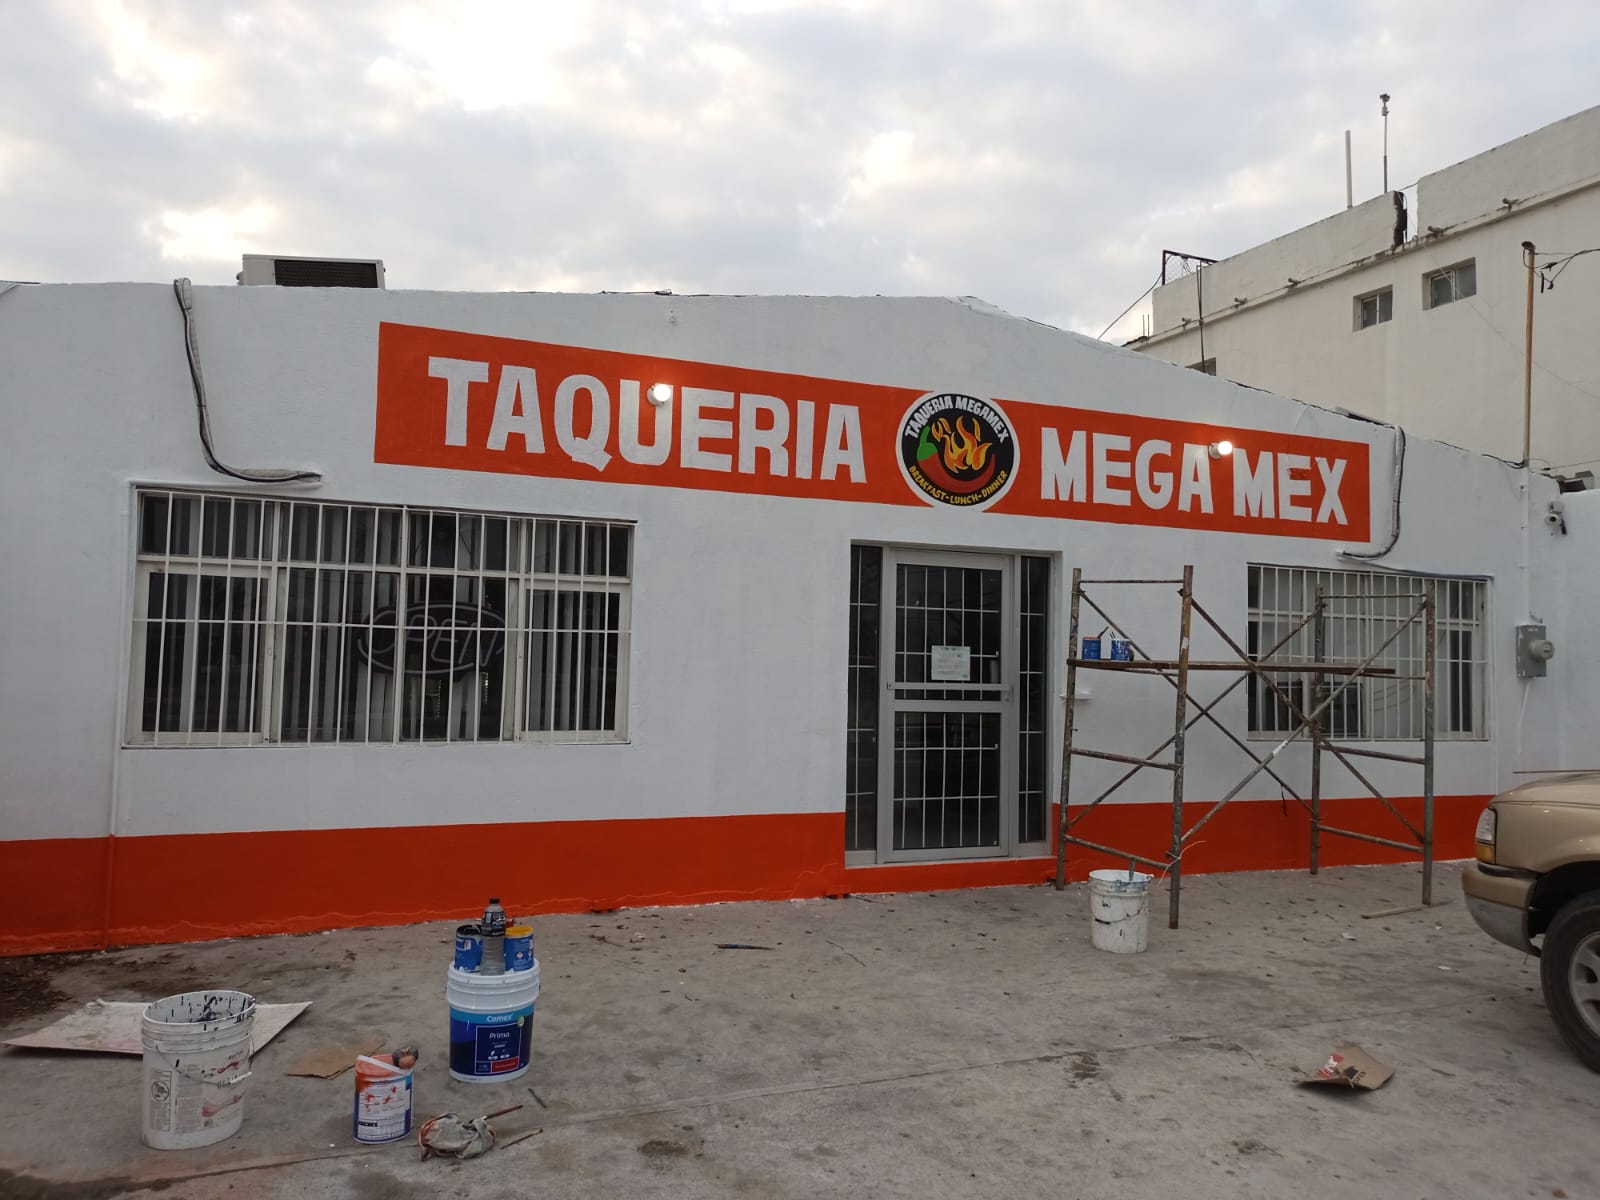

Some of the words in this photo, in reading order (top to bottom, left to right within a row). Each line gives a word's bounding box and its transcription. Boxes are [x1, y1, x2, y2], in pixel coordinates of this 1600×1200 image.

[428, 356, 867, 484] TAQUERIA
[905, 395, 953, 439] TAQUERIA
[955, 396, 1009, 443] MEGAMEX
[1041, 427, 1214, 514] MEGA
[1232, 447, 1348, 525] MEX
[364, 609, 500, 668] OPEN
[486, 1014, 513, 1023] Comex
[489, 1031, 510, 1039] Prima
